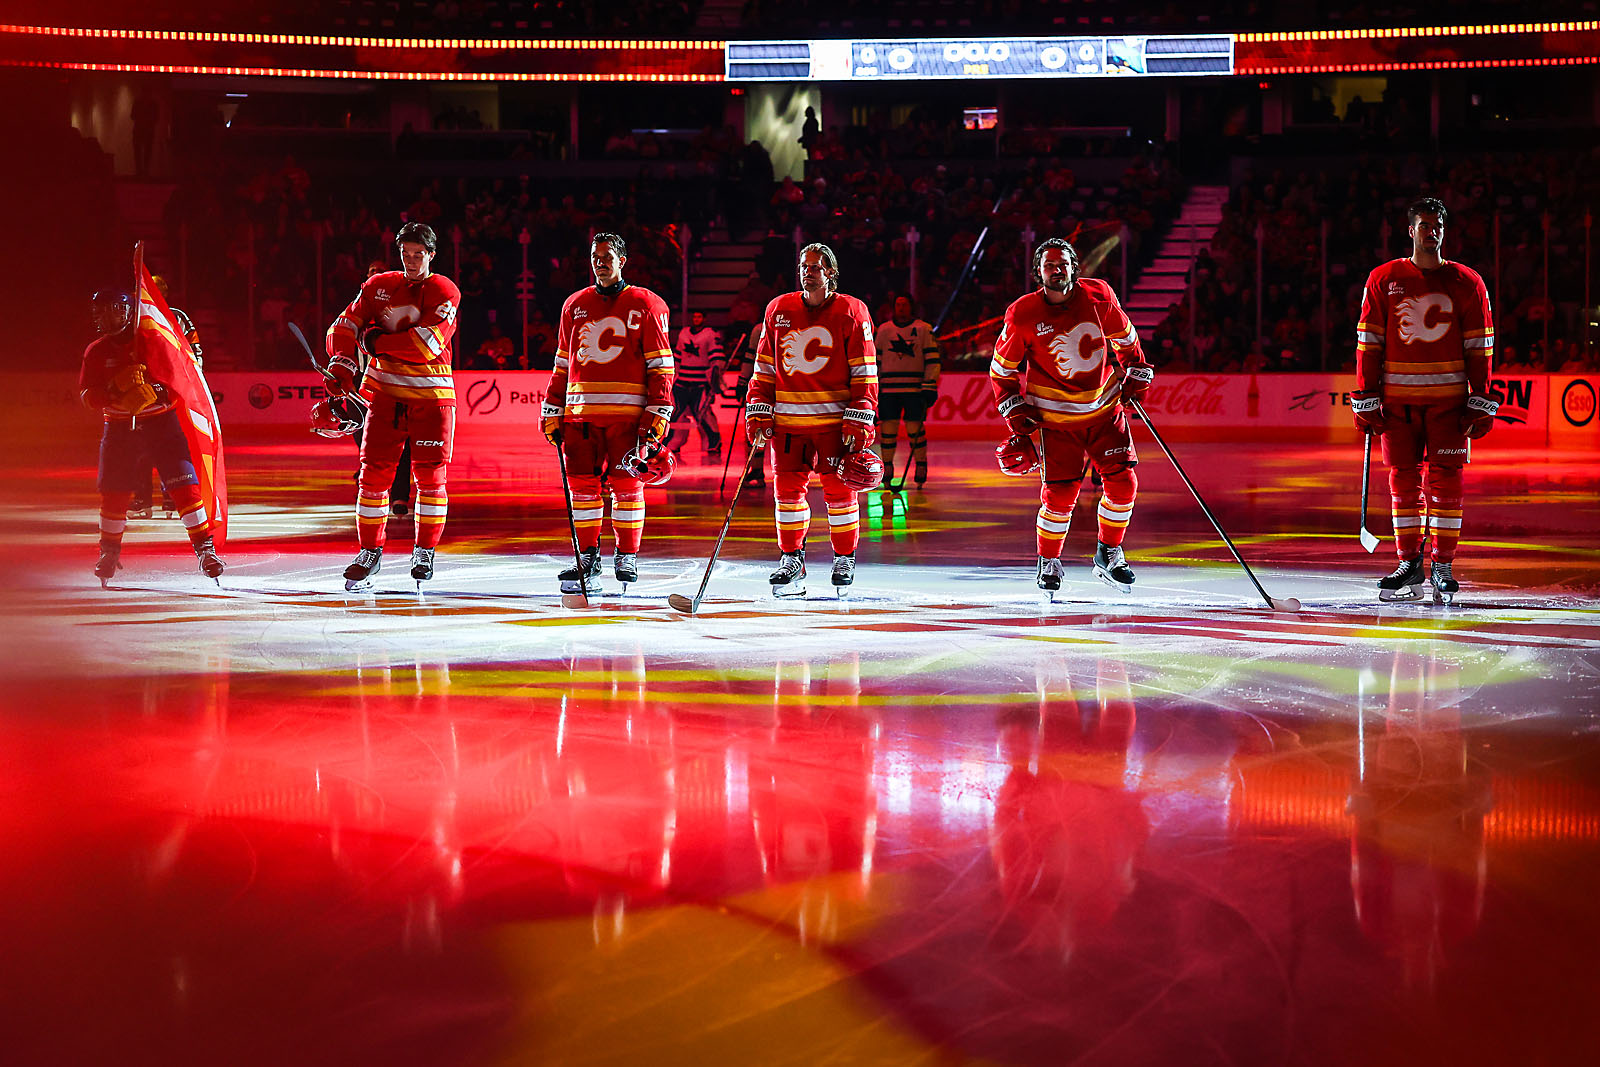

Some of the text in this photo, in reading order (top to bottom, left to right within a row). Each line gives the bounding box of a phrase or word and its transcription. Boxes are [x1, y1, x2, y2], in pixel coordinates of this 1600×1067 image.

[627, 310, 642, 330] C
[1468, 398, 1498, 412] BAUE
[1567, 391, 1592, 412] Esso
